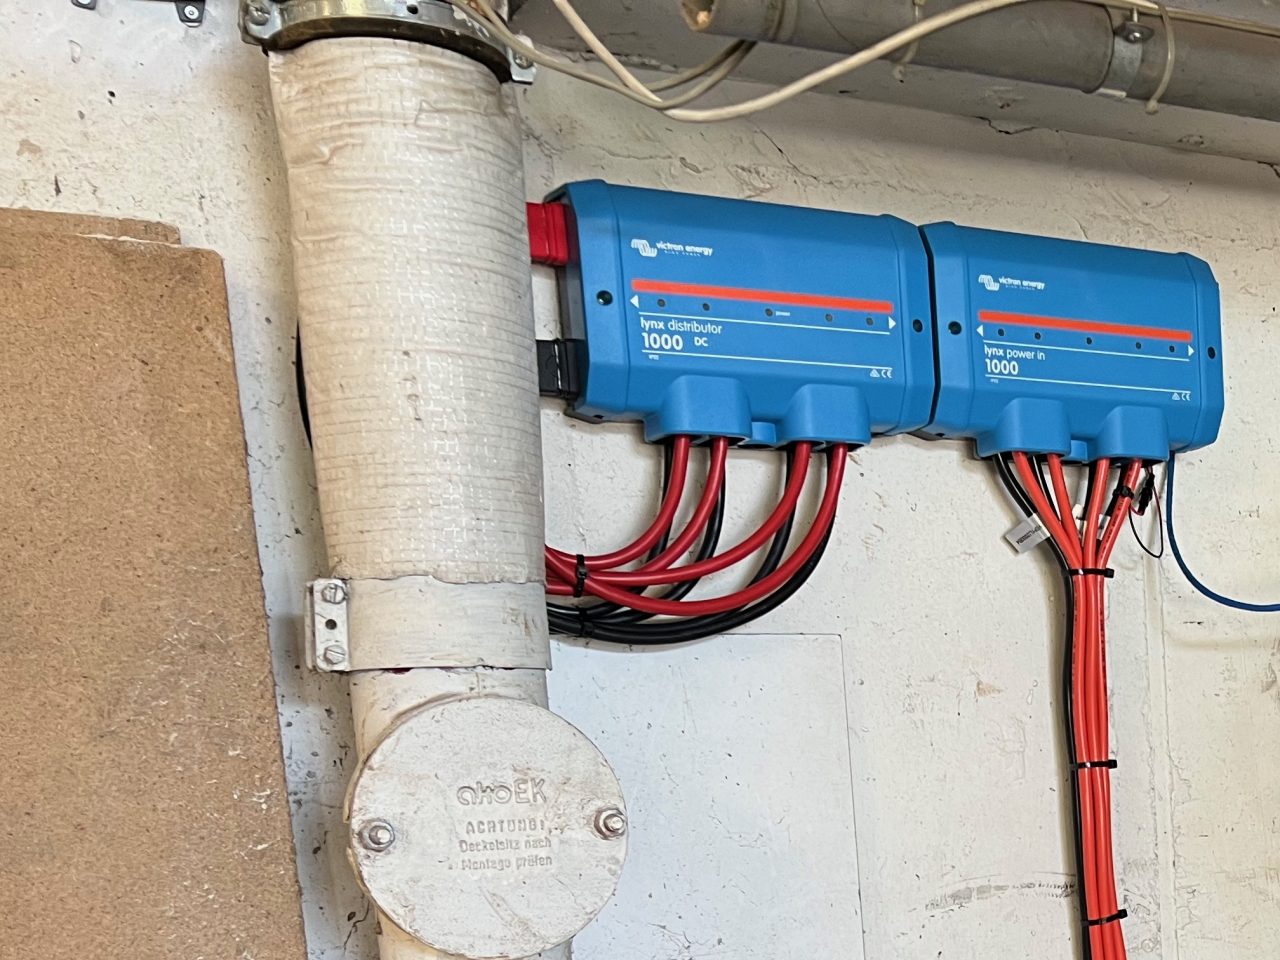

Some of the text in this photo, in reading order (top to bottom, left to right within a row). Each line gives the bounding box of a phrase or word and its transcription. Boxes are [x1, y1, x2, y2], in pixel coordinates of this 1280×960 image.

[656, 241, 684, 252] victron
[685, 245, 713, 256] energy
[999, 276, 1021, 286] victron
[1022, 280, 1045, 290] energy
[640, 316, 722, 335] lynx distributor
[642, 332, 709, 351] 1000 DC
[984, 344, 1046, 360] lynx power in
[985, 358, 1019, 375] 1000
